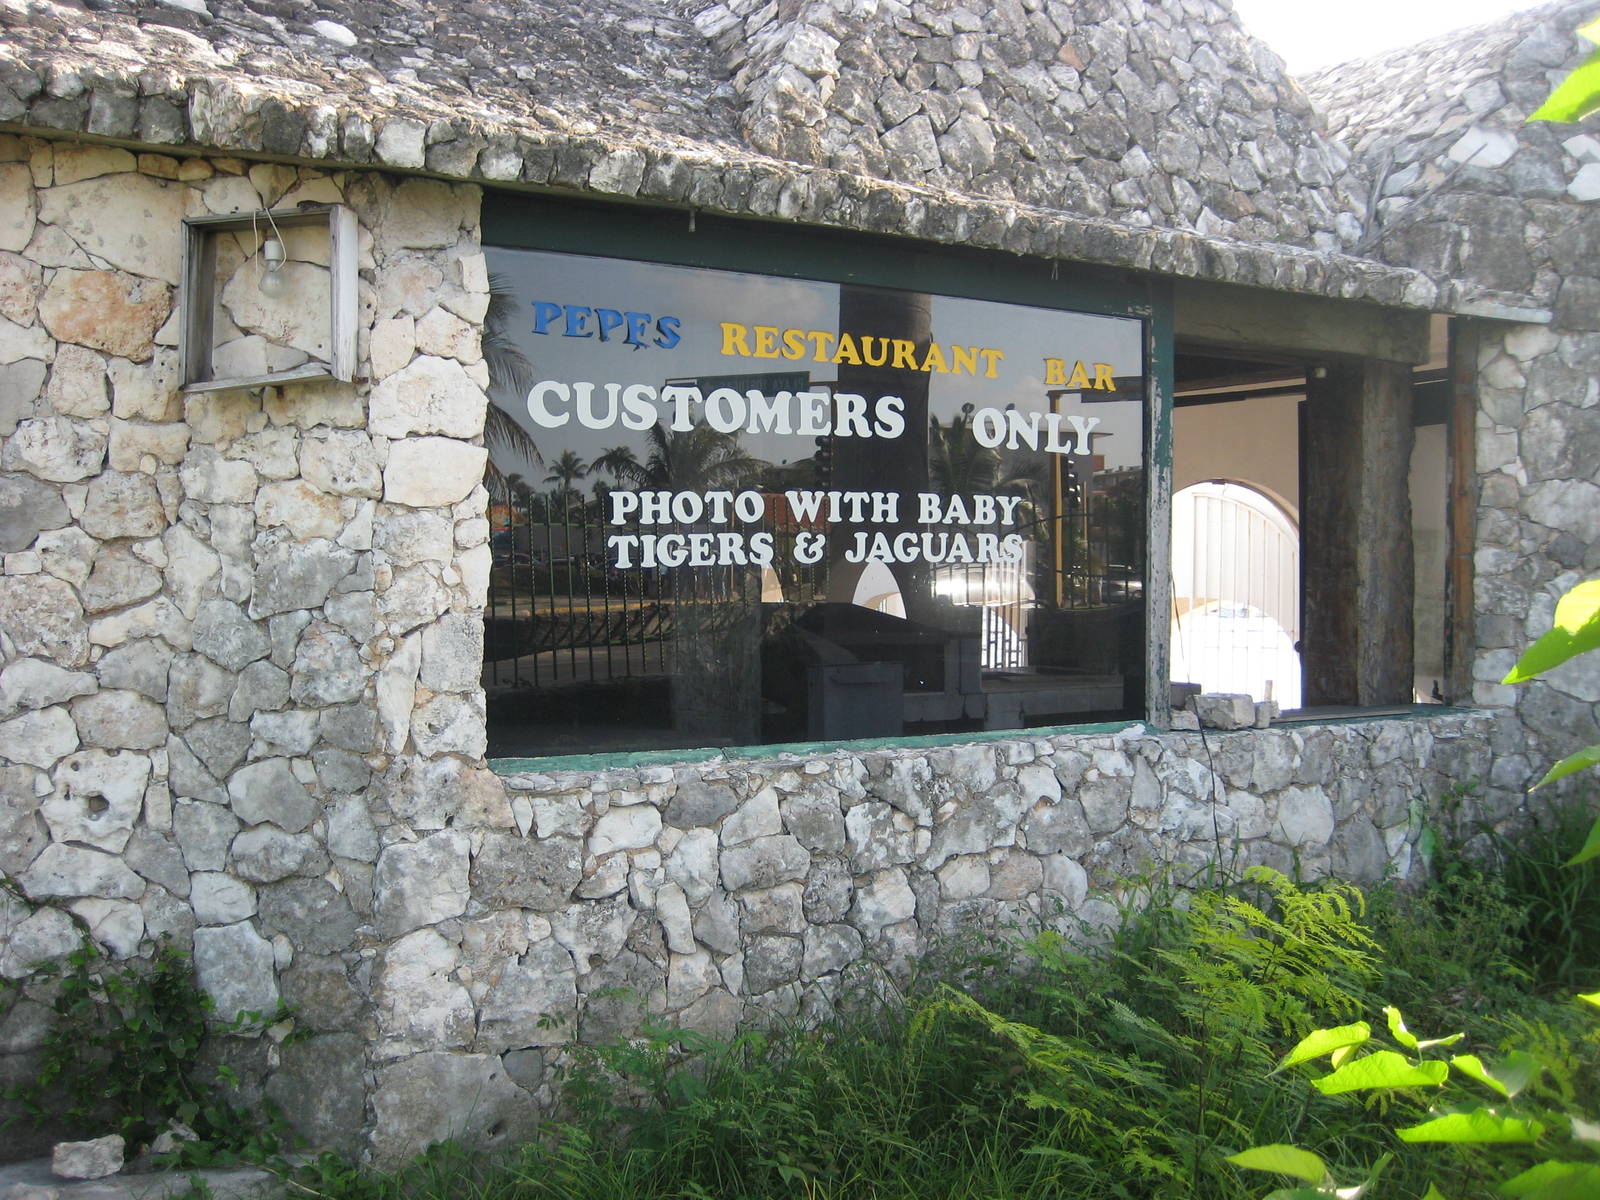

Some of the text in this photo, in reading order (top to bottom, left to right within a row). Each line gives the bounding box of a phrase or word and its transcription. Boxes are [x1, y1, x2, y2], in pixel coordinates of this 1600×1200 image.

[531, 301, 1117, 391] PEPES RESTAURANT BAR
[527, 381, 1100, 455] CUSTOMERS ONLY
[609, 490, 1021, 525] PHOTO WITH BABY
[608, 532, 1023, 568] TIGERS & JAGUARS
